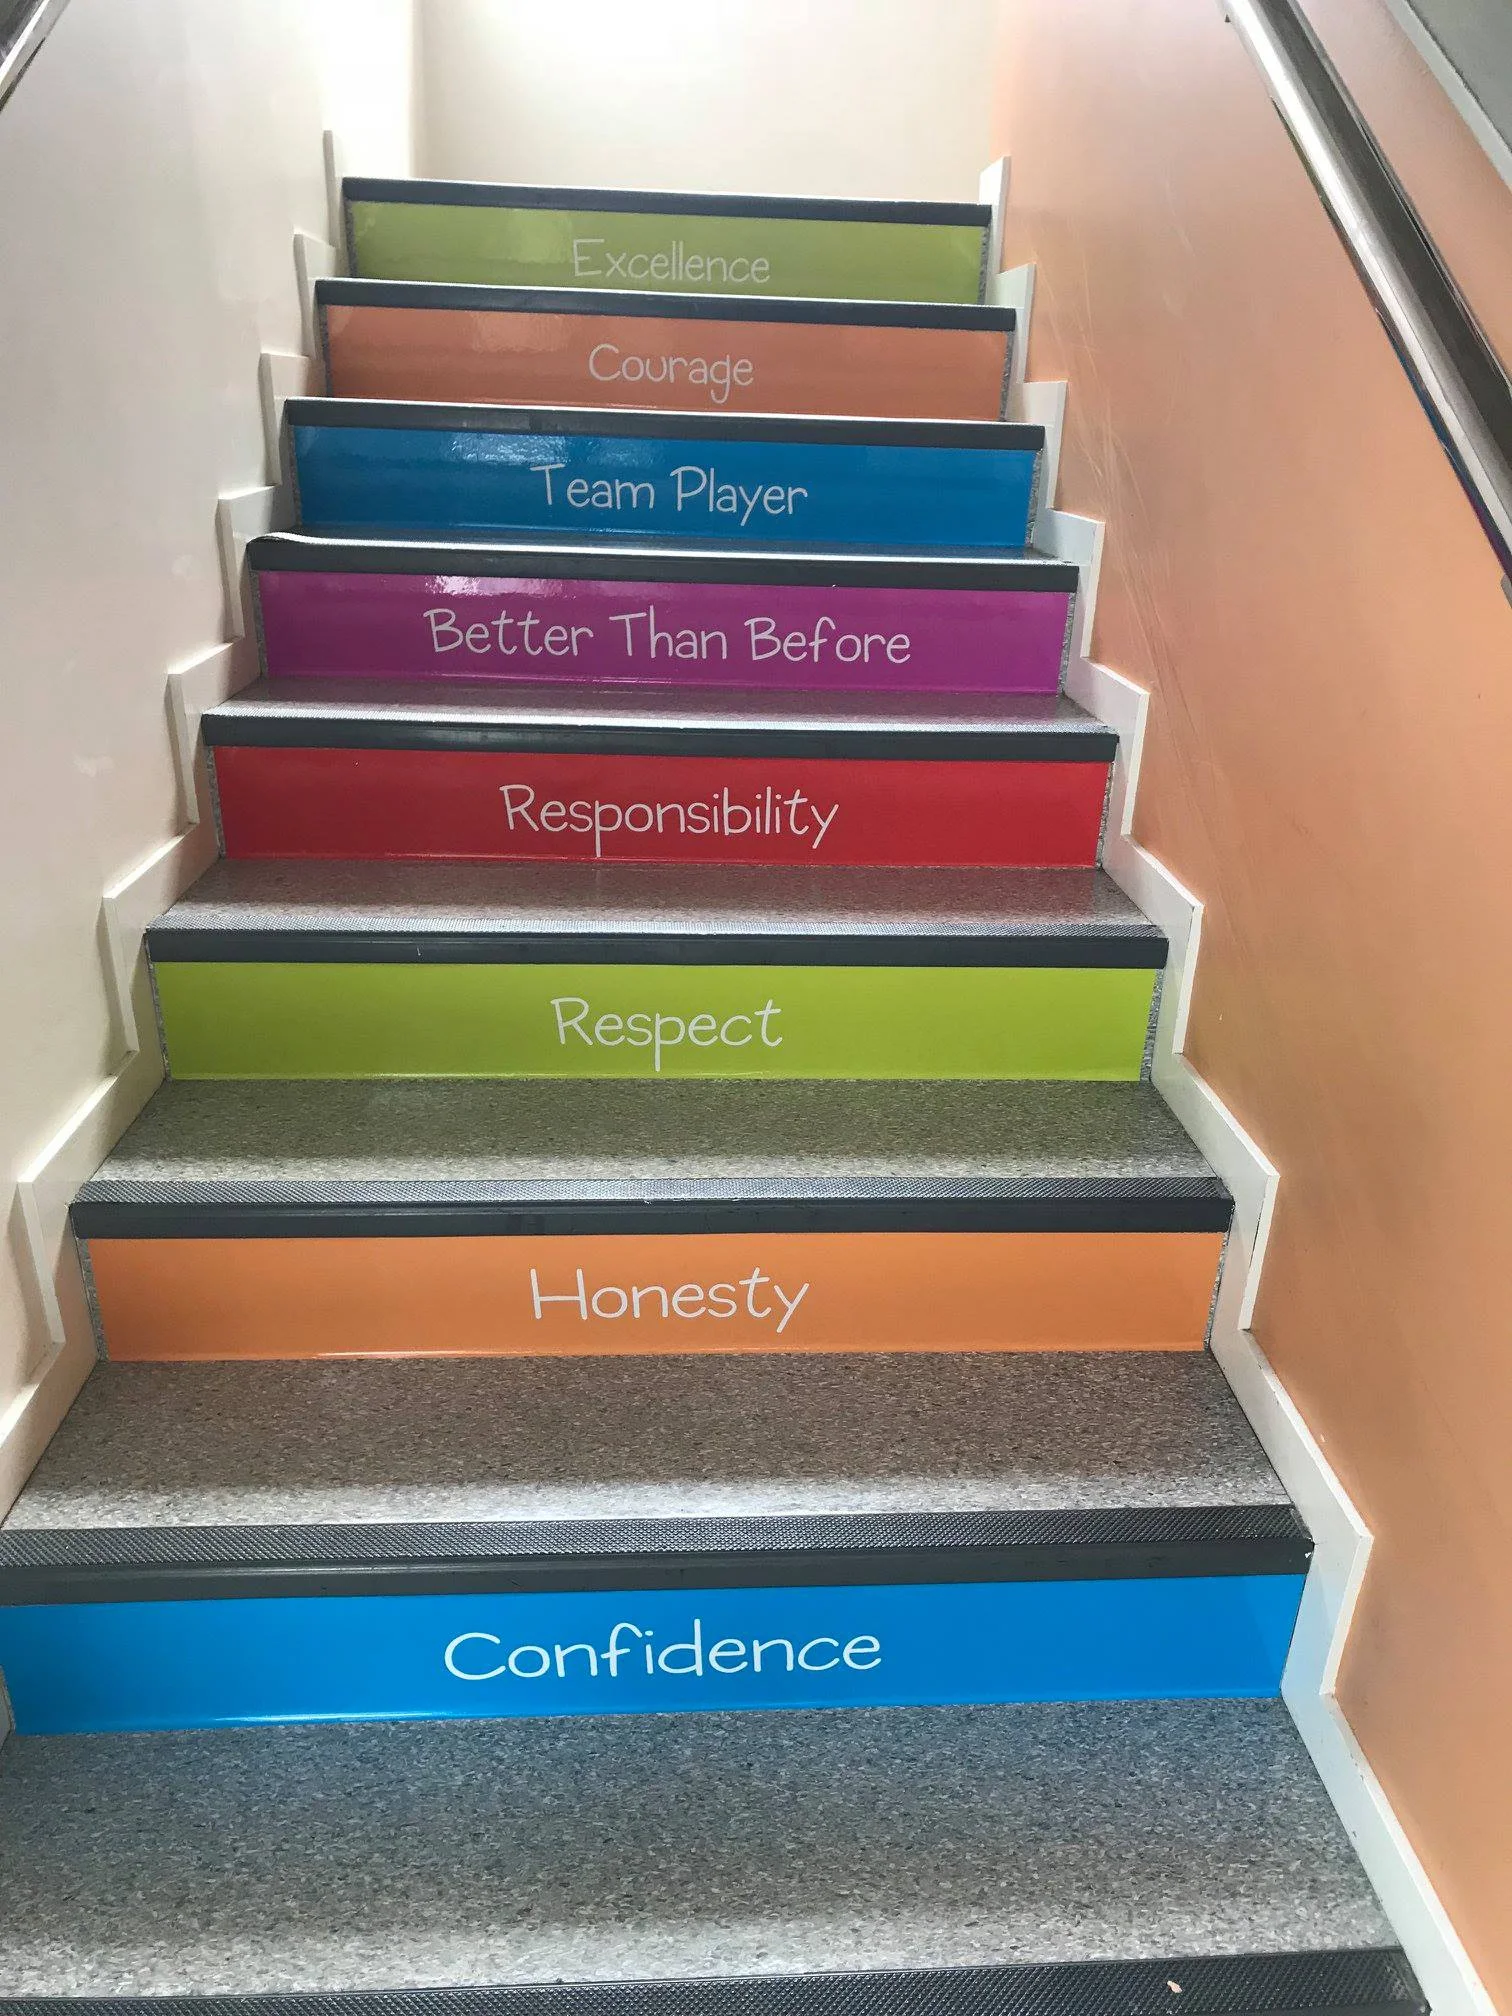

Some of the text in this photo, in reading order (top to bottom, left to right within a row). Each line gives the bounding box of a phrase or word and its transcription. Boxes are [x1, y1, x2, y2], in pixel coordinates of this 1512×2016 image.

[572, 238, 770, 284] Excellence
[588, 344, 754, 404] Courage
[530, 464, 809, 526] Team Player
[423, 606, 911, 664] Better Than Before
[499, 784, 840, 860] Responsibility
[550, 996, 783, 1073] Respect
[530, 1267, 811, 1334] Honesty
[443, 1618, 883, 1681] Confidence
